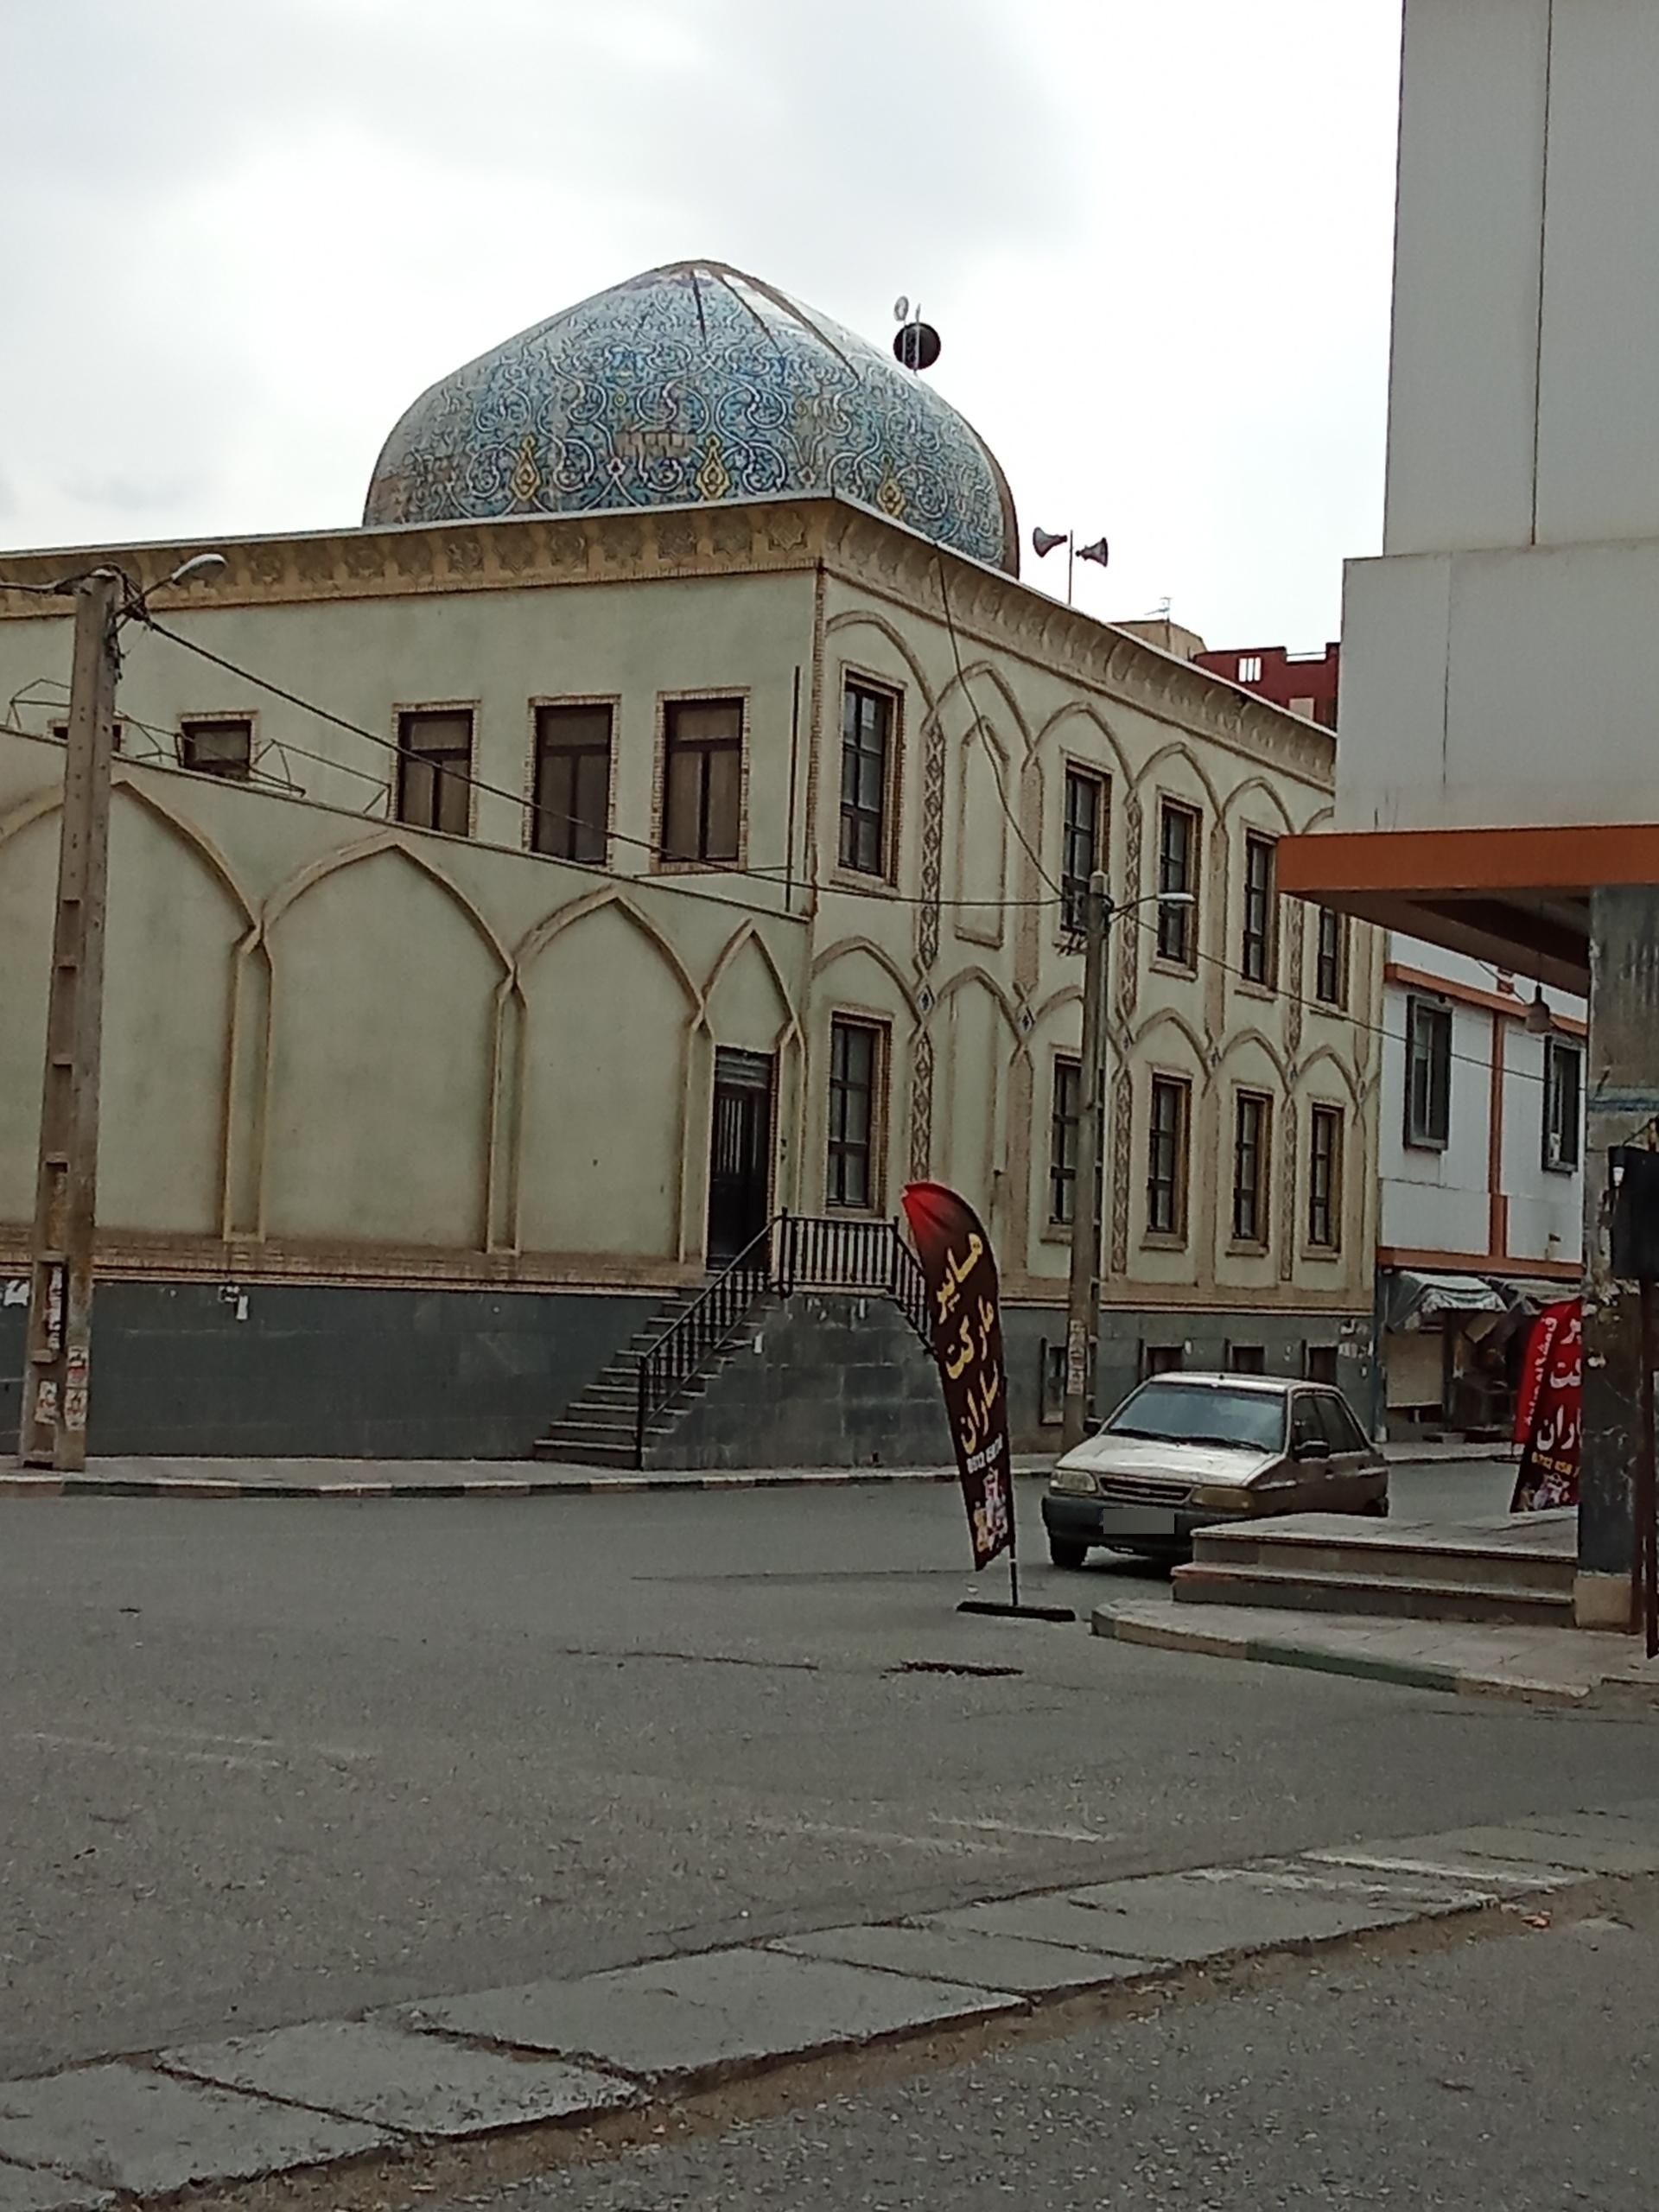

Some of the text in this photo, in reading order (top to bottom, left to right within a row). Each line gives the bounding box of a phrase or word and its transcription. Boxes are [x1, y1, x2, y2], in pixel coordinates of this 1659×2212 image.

[945, 1295, 994, 1380] مارکت
[960, 1358, 1001, 1455] باران
[1536, 1404, 1582, 1451] اران
